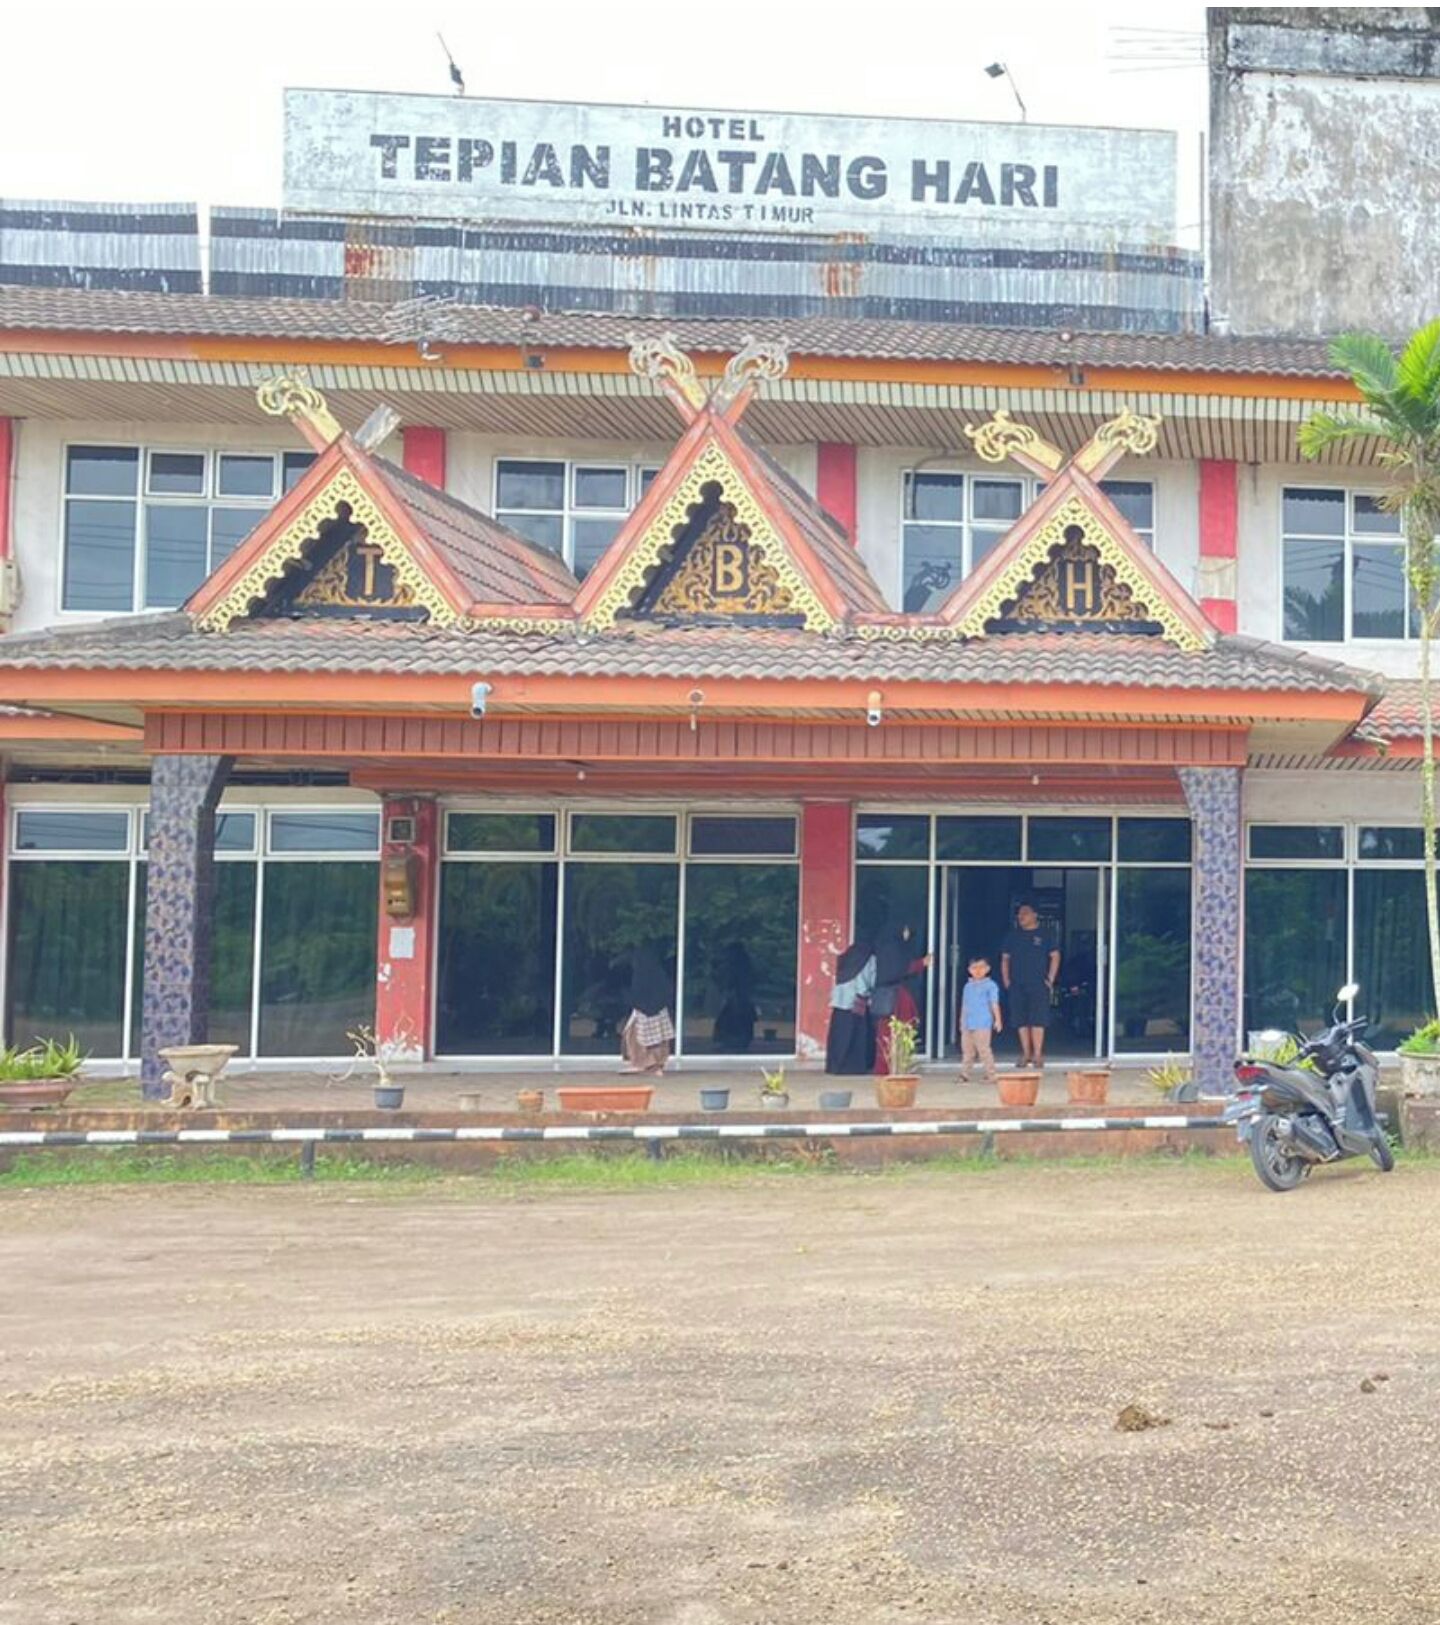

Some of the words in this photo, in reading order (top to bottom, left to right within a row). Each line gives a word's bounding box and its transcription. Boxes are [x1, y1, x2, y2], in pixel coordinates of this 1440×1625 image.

[662, 116, 765, 141] HOTEL
[370, 134, 611, 190] TEPIAN
[635, 147, 888, 200] BATANG
[911, 159, 1058, 208] HARI
[606, 200, 652, 218] JLN.
[660, 202, 733, 221] LINTAS
[743, 204, 814, 224] TIMUR
[356, 547, 384, 596] T
[715, 543, 744, 592] B
[1066, 562, 1094, 610] H
